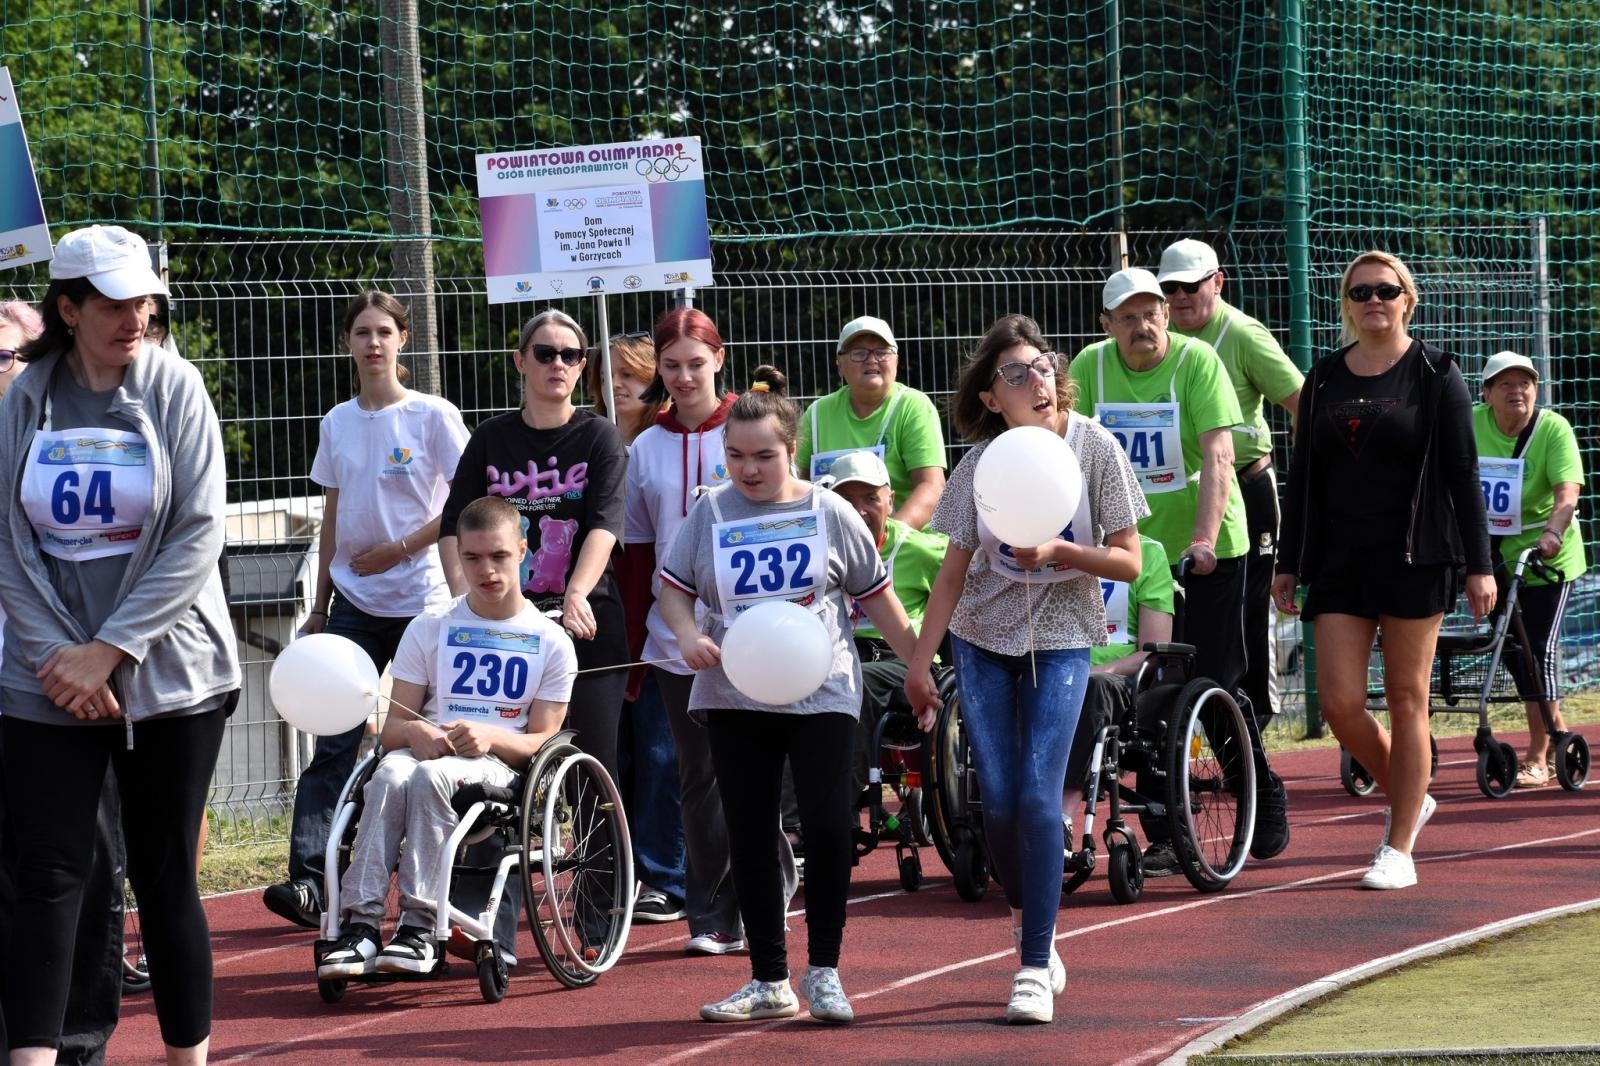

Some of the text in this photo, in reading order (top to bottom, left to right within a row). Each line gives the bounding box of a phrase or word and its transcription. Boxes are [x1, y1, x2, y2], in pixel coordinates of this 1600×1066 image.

[487, 143, 674, 170] POWIATOWA OLIMPIADA
[527, 161, 629, 178] NIEPEŁNOSPRAWNYCH
[584, 216, 602, 226] Dom
[554, 225, 634, 240] Pomocy Społecznej
[560, 242, 573, 251] im.
[575, 240, 596, 250] Jana
[598, 238, 623, 249] Pawła
[570, 249, 622, 262] w Gorzycach
[51, 470, 116, 525] 64
[730, 543, 814, 595] 232
[450, 651, 529, 700] 230
